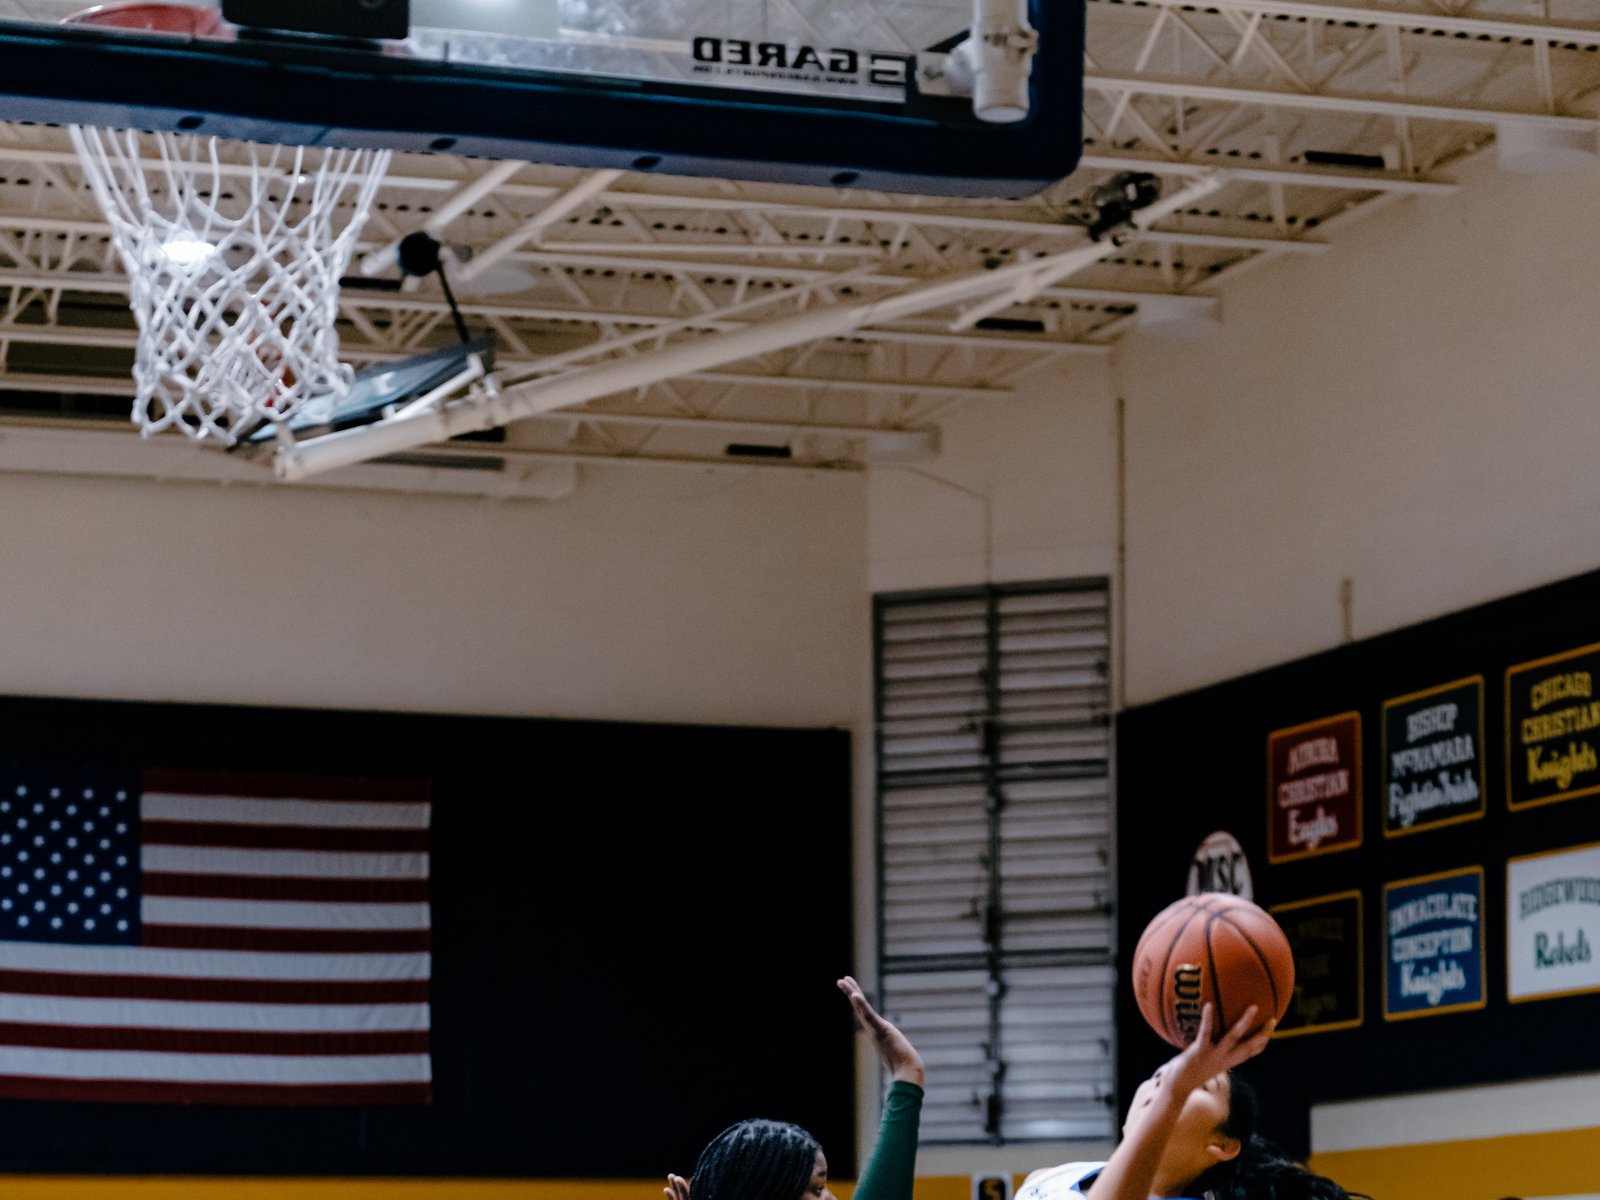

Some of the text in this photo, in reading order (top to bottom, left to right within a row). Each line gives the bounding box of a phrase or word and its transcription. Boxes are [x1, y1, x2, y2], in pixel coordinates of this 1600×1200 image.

[1531, 672, 1591, 710] CHICAGO
[1407, 703, 1458, 743] BISHOP
[1527, 742, 1597, 788] Knights
[1390, 893, 1477, 935] IMMACULATE
[1392, 927, 1472, 962] CONCEPTION
[1535, 928, 1592, 969] Rebels
[1401, 960, 1466, 1004] Knights
